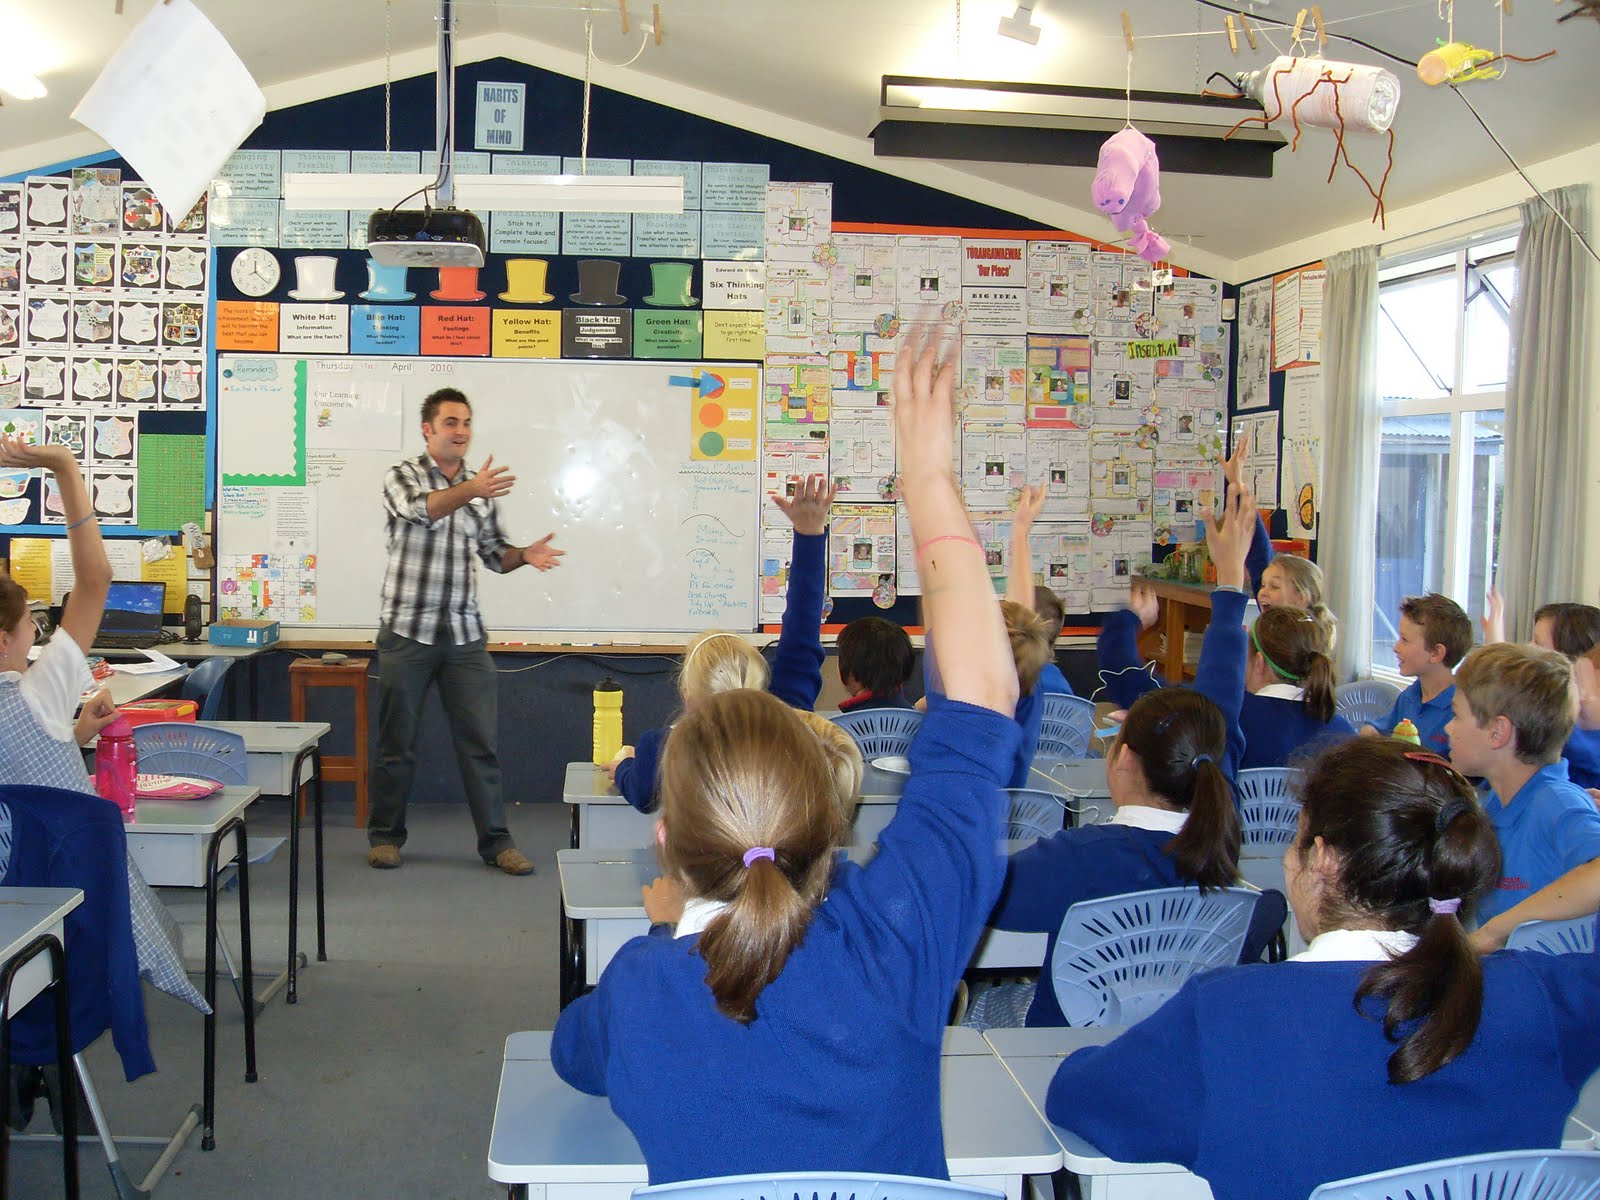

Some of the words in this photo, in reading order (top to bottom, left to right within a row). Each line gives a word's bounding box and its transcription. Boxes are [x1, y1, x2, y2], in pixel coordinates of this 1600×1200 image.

[483, 88, 518, 103] HABITS
[494, 109, 506, 123] OF
[486, 129, 512, 145] MIND
[230, 154, 267, 162] anaging
[298, 153, 336, 162] Thinking
[223, 162, 275, 171] mpulsivity
[296, 213, 332, 221] Accuracy
[497, 211, 555, 219] Persisting
[495, 229, 523, 238] Complete
[709, 281, 724, 289] Six
[726, 282, 765, 291] Thinking
[292, 313, 316, 321] White
[576, 316, 600, 324] Black
[502, 318, 531, 326] Yellow
[646, 318, 671, 326] Green
[237, 365, 273, 373] Reminders
[316, 362, 353, 372] Thursday
[392, 363, 412, 372] April
[430, 364, 453, 373] 2010
[330, 391, 359, 401] Learning
[314, 400, 345, 408] Outcome
